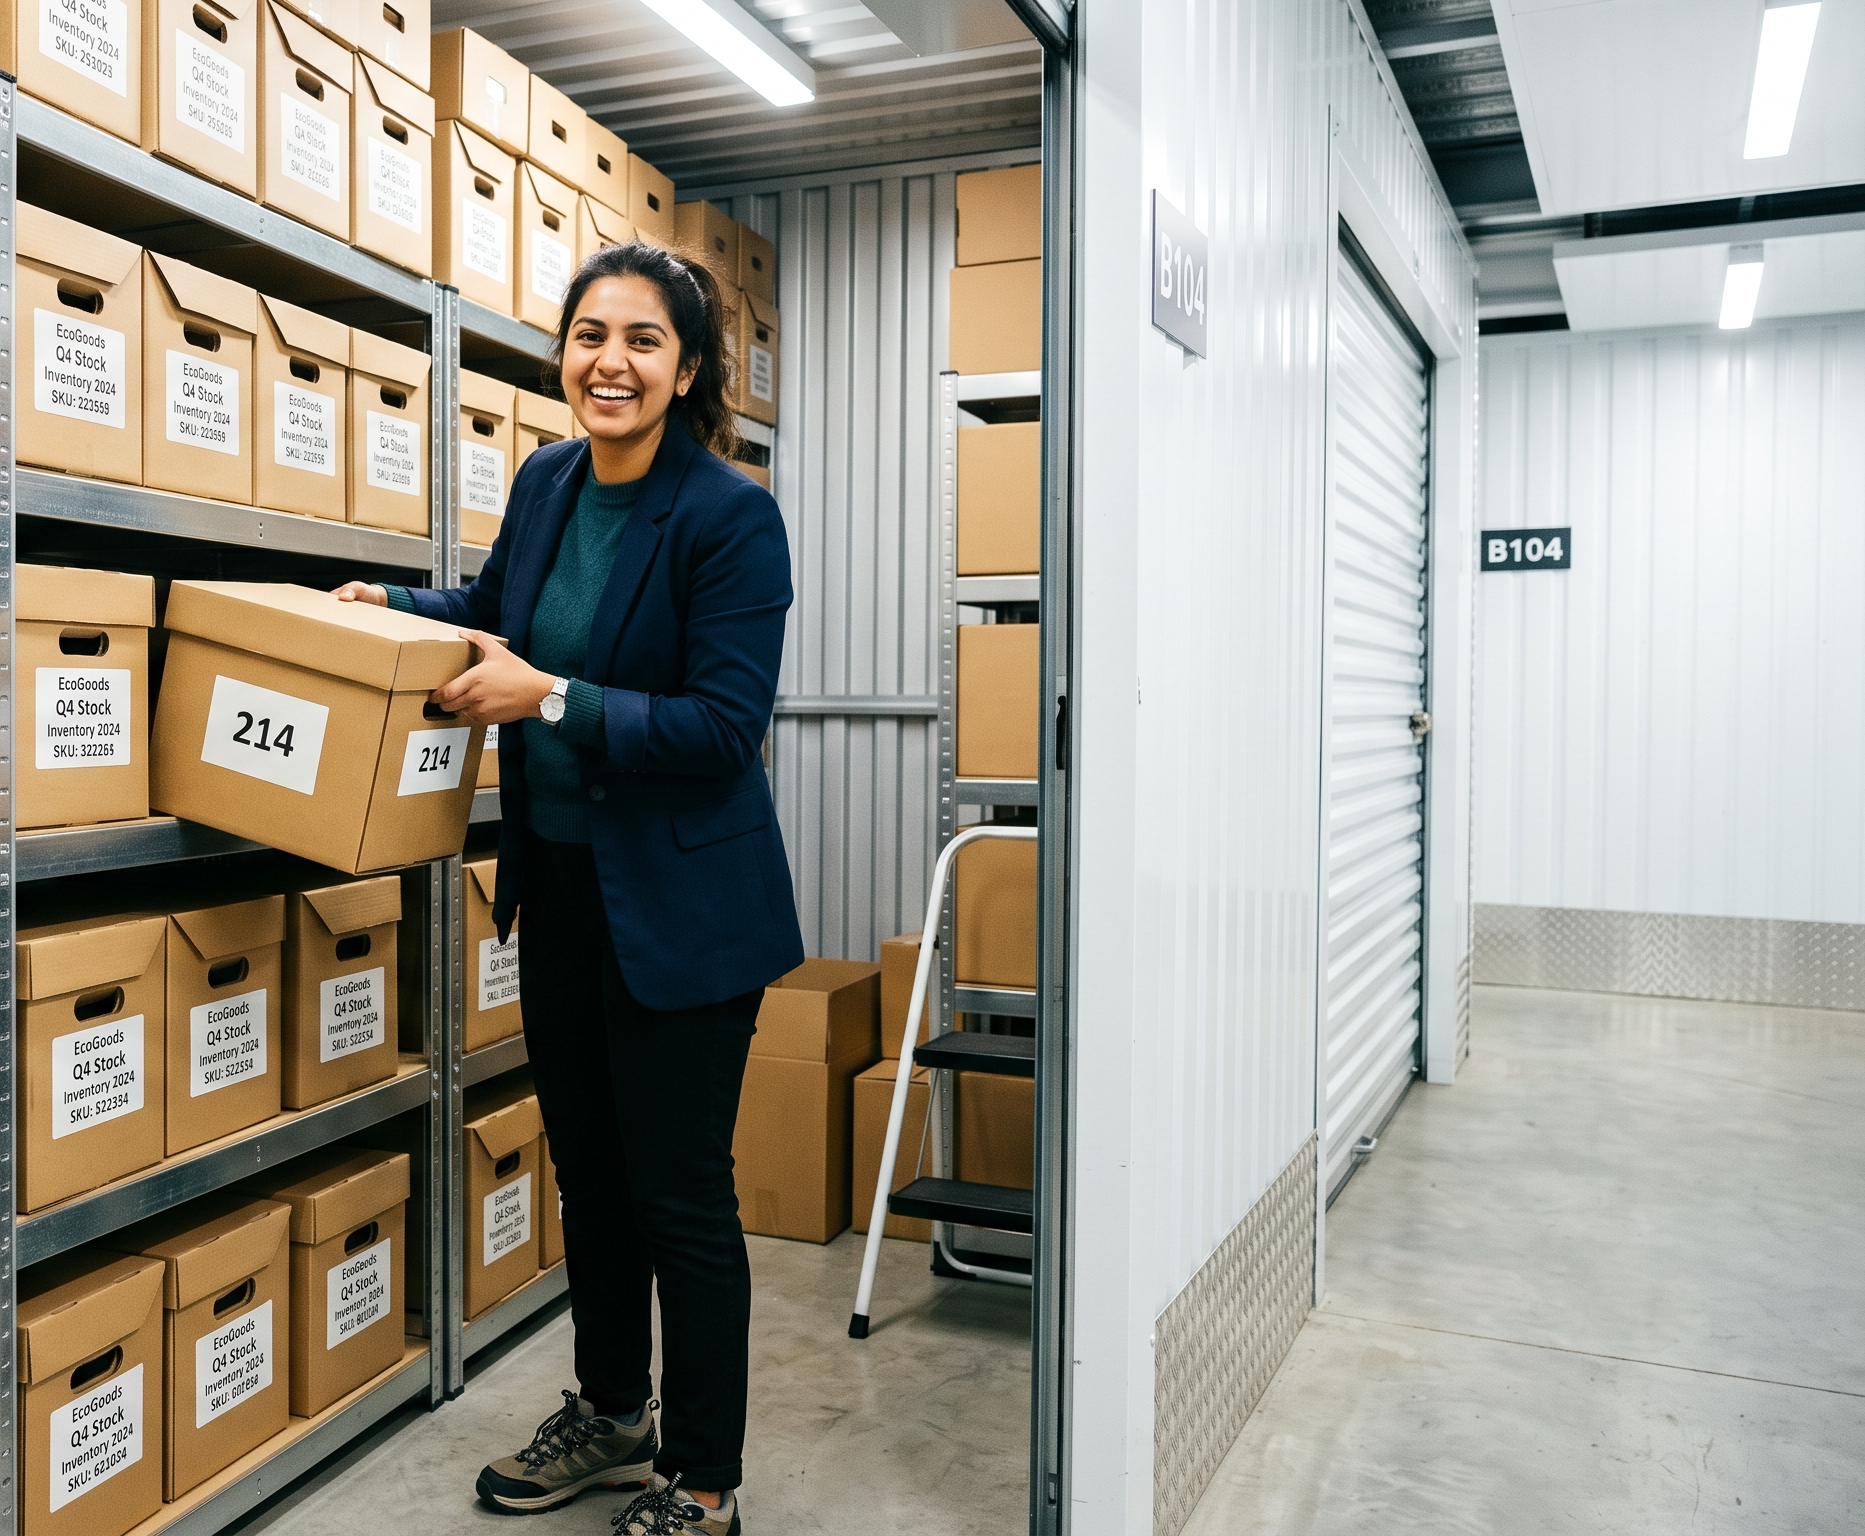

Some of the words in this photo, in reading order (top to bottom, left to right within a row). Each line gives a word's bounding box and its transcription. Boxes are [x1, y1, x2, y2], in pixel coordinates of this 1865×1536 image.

[80, 4, 107, 33] Stock
[49, 9, 95, 50] Inventory
[98, 37, 118, 60] 2024
[56, 36, 77, 59] SKU:
[1161, 230, 1204, 325] B104
[56, 323, 106, 349] EcoGoods
[56, 346, 71, 363] Q4
[75, 350, 106, 373] Stock
[45, 366, 92, 393] Inventory
[95, 379, 116, 396] 2024
[184, 363, 222, 385] EcoGoods
[52, 390, 76, 407] SKU:
[78, 397, 110, 415] 223559
[183, 382, 195, 398] Q4
[198, 386, 223, 405] Stock
[289, 394, 322, 413] EcoGoods
[173, 401, 211, 423] Inventory
[214, 411, 230, 425] 2024
[289, 411, 299, 425] Q4
[302, 414, 323, 431] Stock
[180, 421, 199, 436] SKU:
[1488, 537, 1563, 563] B104
[59, 677, 109, 690] EcoGoods
[56, 699, 74, 717] Q4
[78, 699, 112, 715] Stock
[48, 724, 95, 739] Inventory
[98, 723, 120, 735] 2024
[233, 711, 295, 758] 214
[54, 745, 78, 757] SKU:
[419, 745, 451, 772] 214
[208, 1001, 249, 1024] EcoGoods
[334, 1002, 346, 1017] Q4
[349, 995, 372, 1013] Stock
[207, 1029, 221, 1046] Q4
[224, 1020, 251, 1040] Stock
[328, 1019, 361, 1035] Inventory
[75, 1029, 124, 1056] EcoGoods
[200, 1047, 239, 1067] Inventory
[241, 1038, 259, 1054] 2024
[73, 1061, 91, 1080] Q4
[94, 1050, 126, 1073] Stock
[204, 1068, 224, 1084] SKU:
[64, 1080, 110, 1104] Inventory
[113, 1070, 135, 1088] 2024
[70, 1105, 93, 1123] SKU:
[341, 1283, 353, 1301] Q4
[356, 1270, 378, 1293] Stock
[213, 1353, 227, 1373] Q4
[230, 1337, 257, 1363] Stock
[72, 1385, 122, 1423] EcoGoods
[71, 1424, 89, 1448] Q4
[92, 1406, 124, 1437] Stock
[62, 1440, 110, 1475] Inventory
[112, 1423, 134, 1447] 2024
[68, 1470, 91, 1492] SKU:
